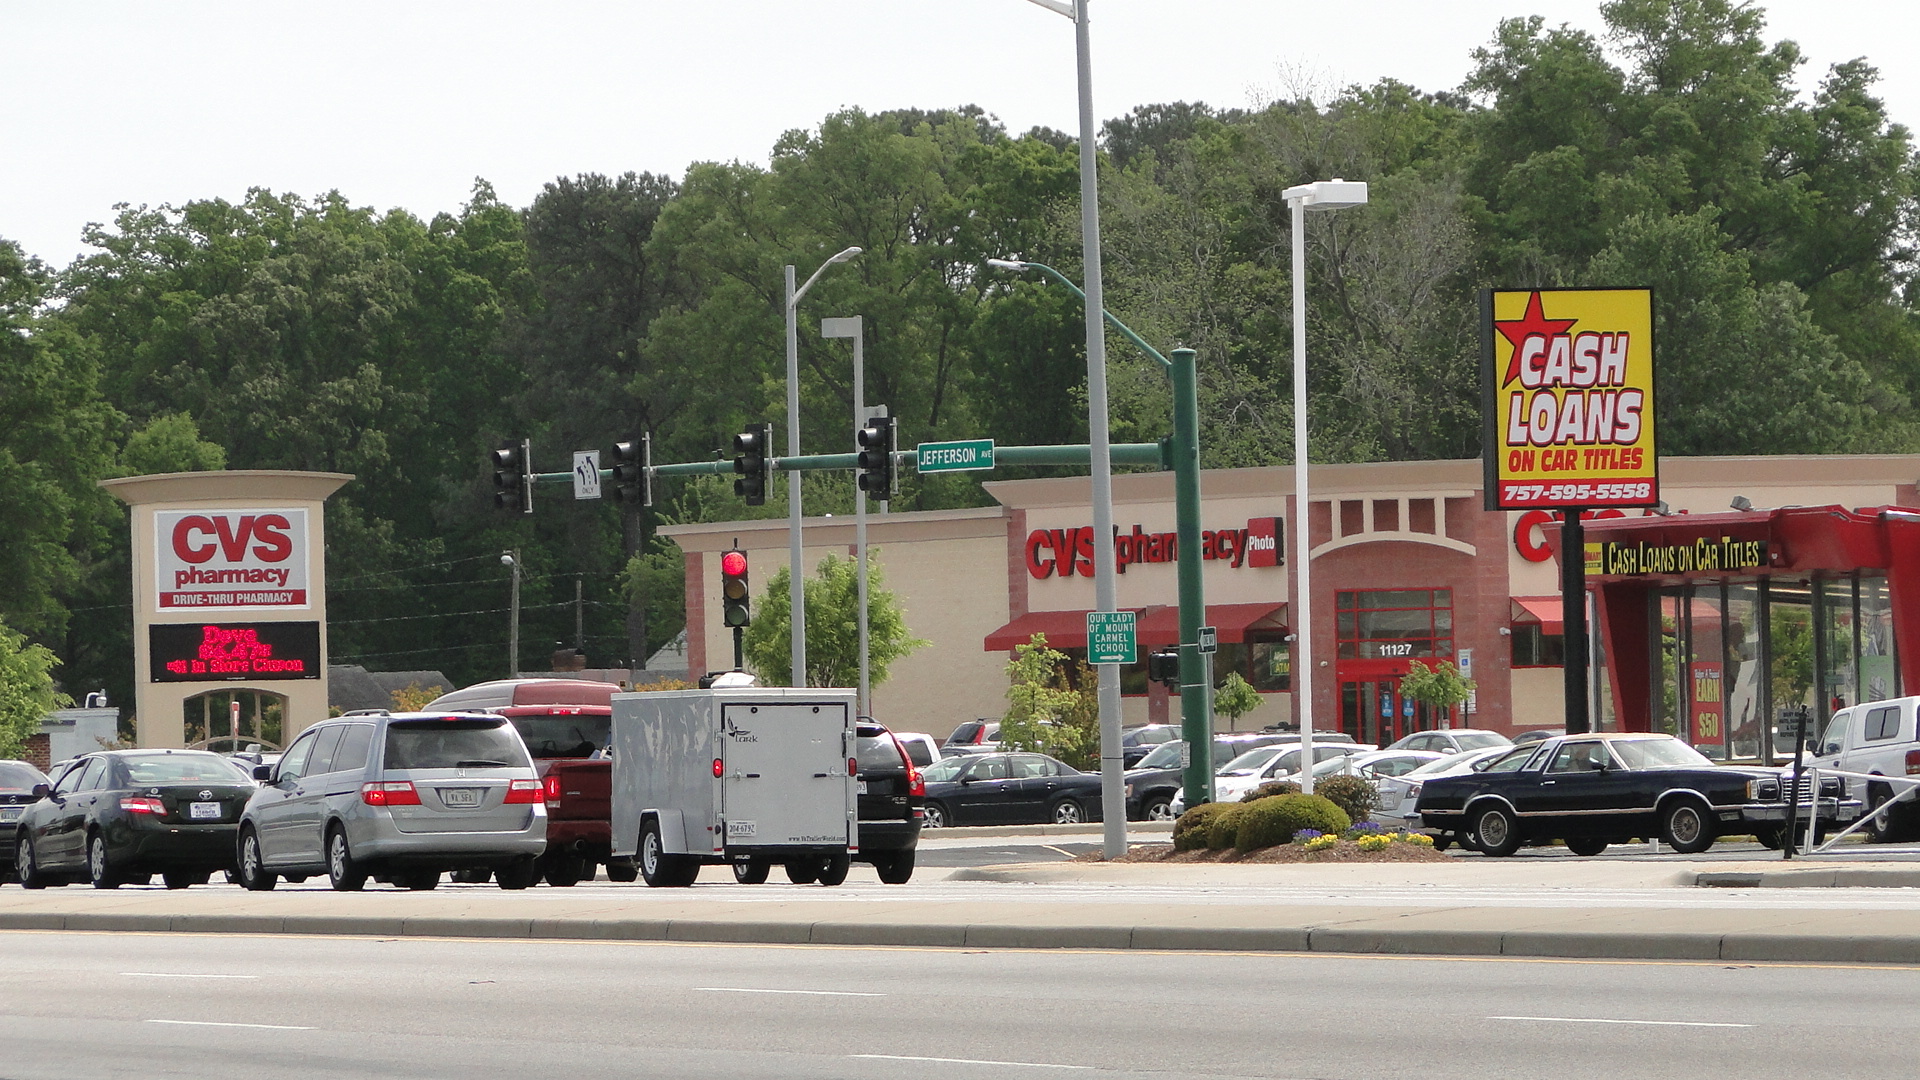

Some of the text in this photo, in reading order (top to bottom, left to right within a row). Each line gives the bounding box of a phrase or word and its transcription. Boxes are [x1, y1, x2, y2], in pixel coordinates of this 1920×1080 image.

[1519, 331, 1630, 390] CASH
[1506, 389, 1645, 448] LOANS
[920, 447, 992, 466] JEFFERSON AVE
[1508, 447, 1643, 472] ON CAR TITLES
[1504, 483, 1651, 501] 757-595-5558
[172, 513, 293, 564] CVS
[1248, 535, 1275, 551] Photo
[175, 566, 290, 589] pharmacy
[172, 592, 293, 605] DRIVE-THRU PHARMACY
[1089, 613, 1133, 623] OUR LADY
[1089, 623, 1134, 633] OF MOUNT
[1095, 633, 1129, 643] CARMEL
[1095, 643, 1130, 653] SCHOOL
[1379, 644, 1412, 656] 11127
[1696, 678, 1720, 702] EARN
[1699, 711, 1718, 738] $50
